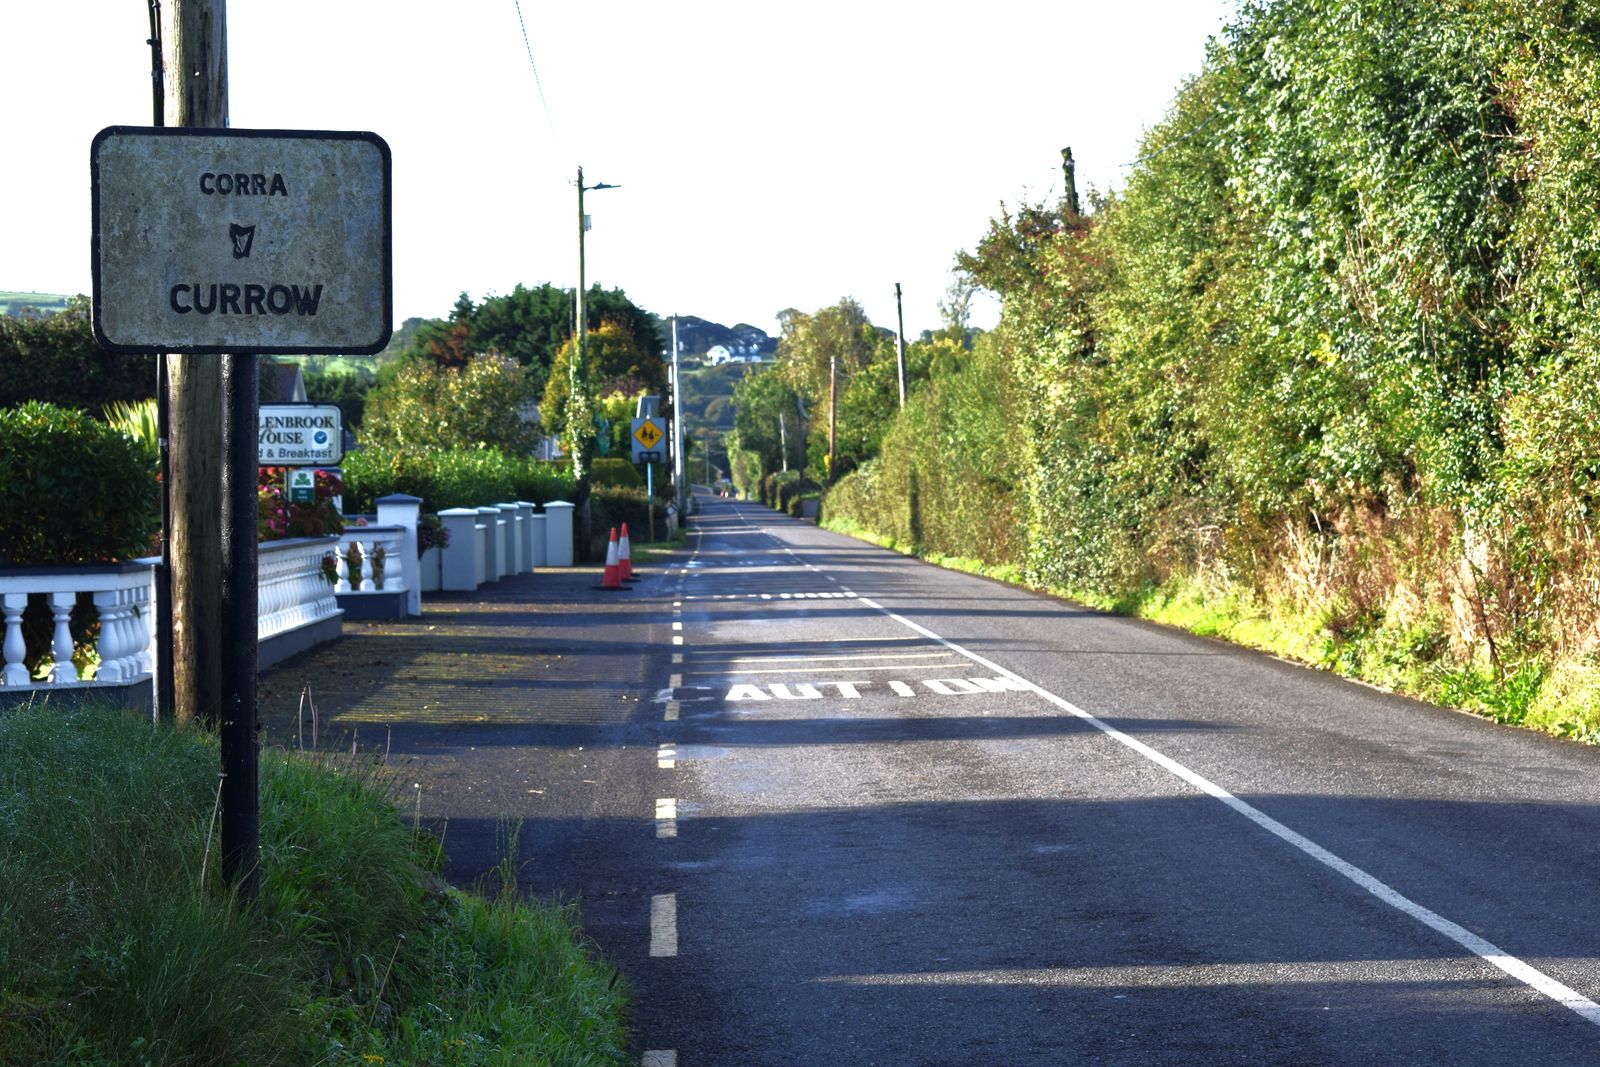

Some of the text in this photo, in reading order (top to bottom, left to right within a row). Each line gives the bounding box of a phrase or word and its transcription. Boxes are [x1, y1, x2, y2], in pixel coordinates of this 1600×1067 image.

[199, 172, 288, 197] CORRA
[169, 283, 324, 316] CURROW
[279, 448, 332, 458] Breakfast
